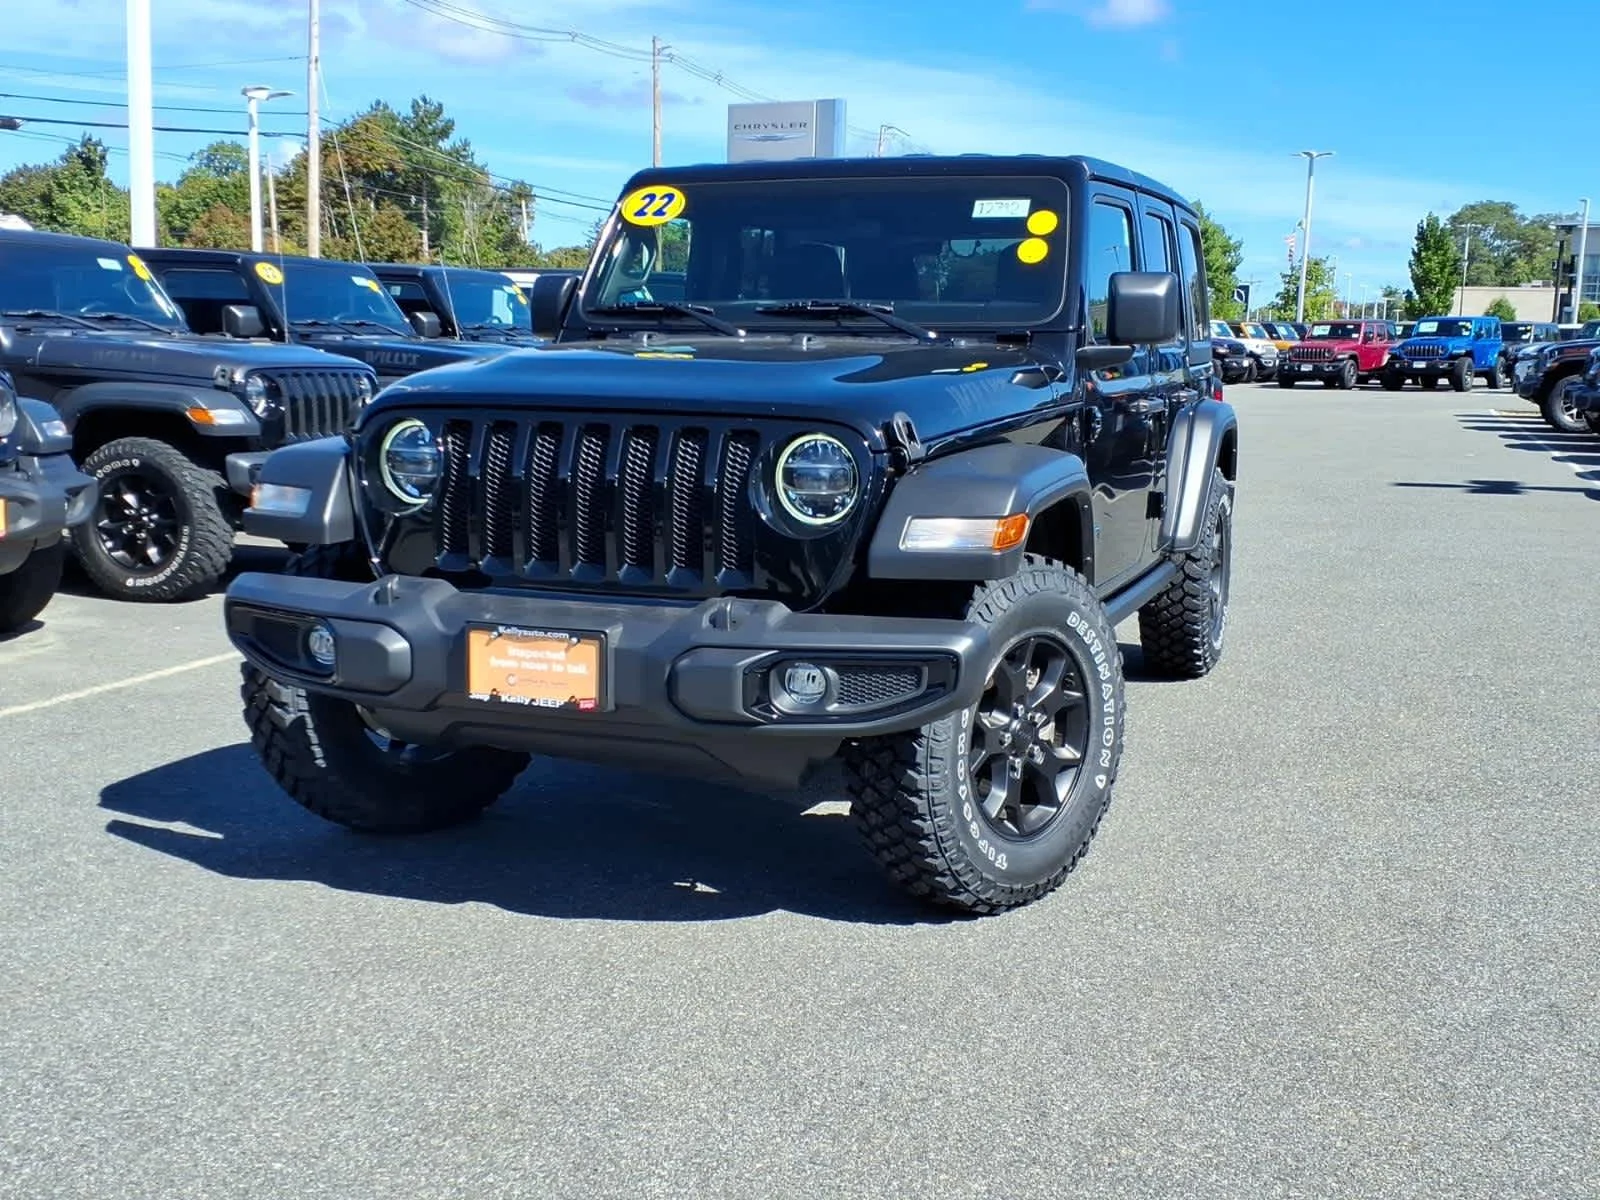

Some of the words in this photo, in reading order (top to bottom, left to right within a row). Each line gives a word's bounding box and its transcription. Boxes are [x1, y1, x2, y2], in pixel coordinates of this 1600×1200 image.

[733, 121, 809, 131] CHRYSLER
[633, 192, 676, 218] 22
[1065, 611, 1117, 768] DESTINATION
